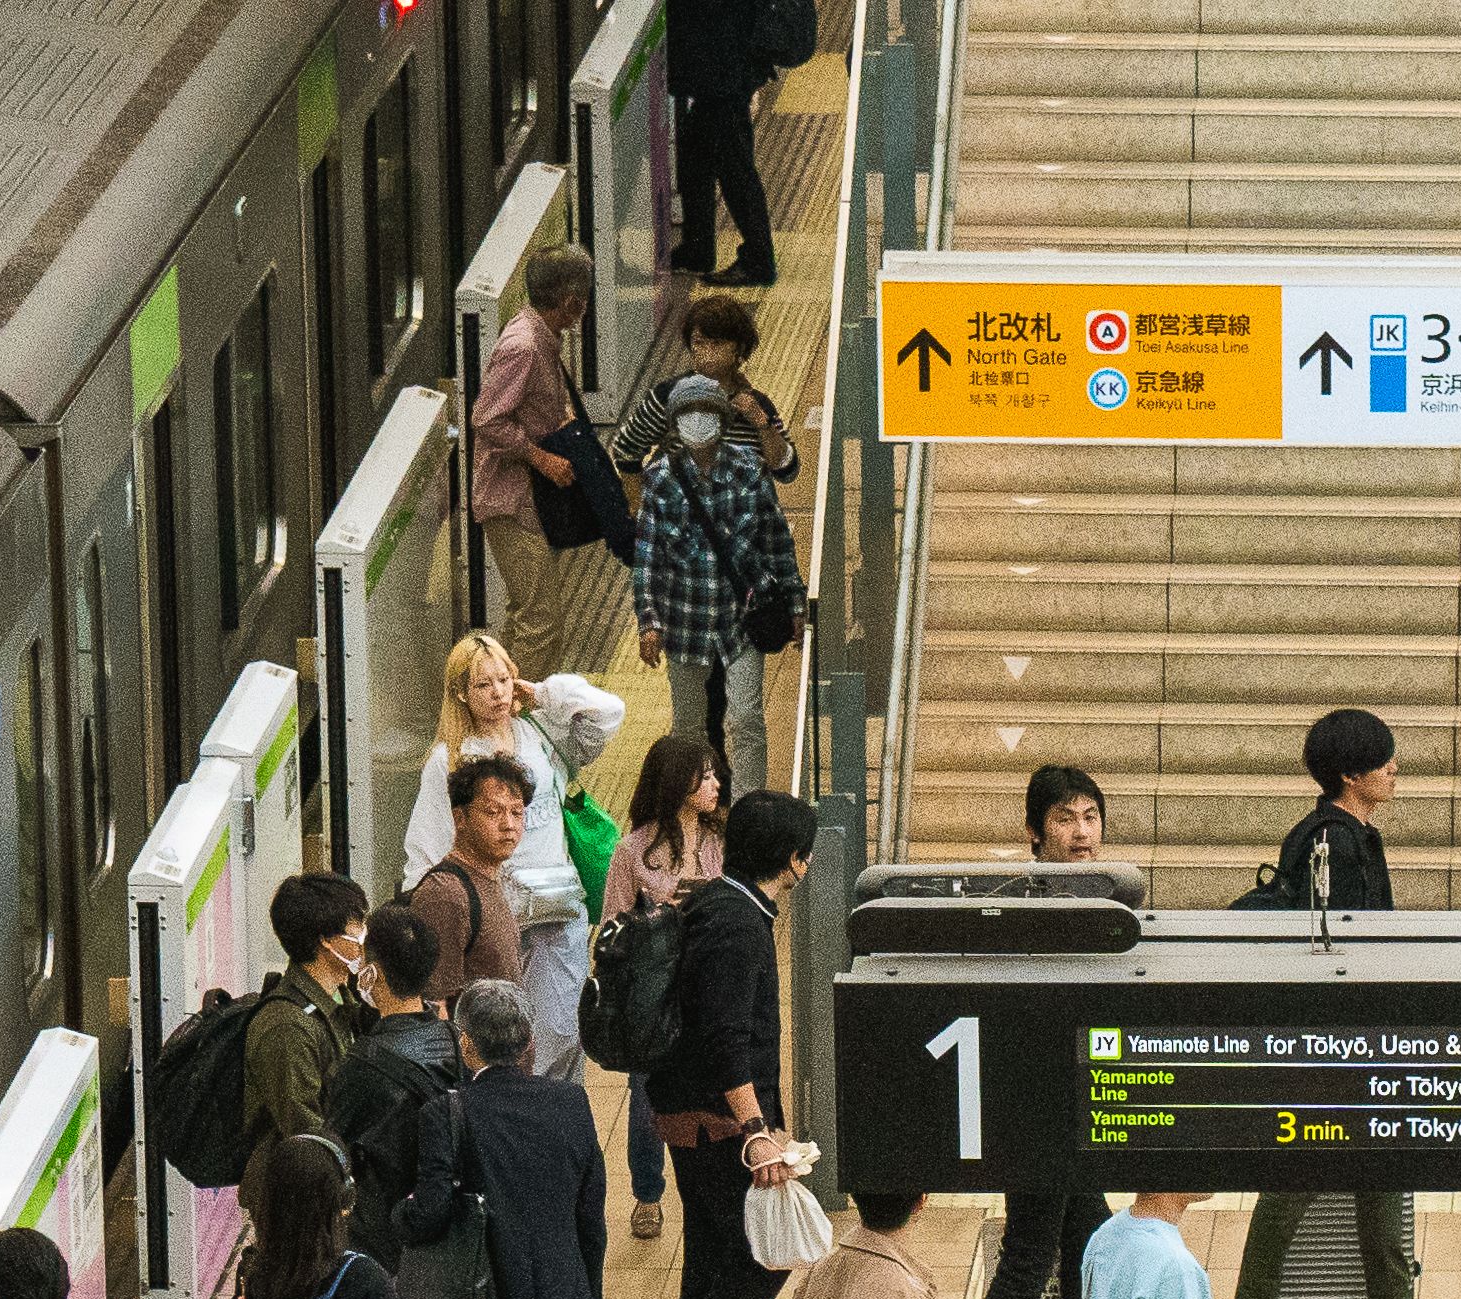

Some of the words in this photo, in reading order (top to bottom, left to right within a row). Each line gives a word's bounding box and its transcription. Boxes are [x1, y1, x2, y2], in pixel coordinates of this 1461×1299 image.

[967, 312, 1061, 342] 北改札
[1101, 325, 1114, 338] A
[1135, 313, 1251, 336] 都営浅草線
[1376, 324, 1400, 342] JK
[1135, 340, 1161, 354] Toei
[1164, 340, 1219, 354] Asakusa
[1222, 340, 1249, 354] Line
[967, 349, 1017, 364] North
[1024, 349, 1067, 365] Gate
[1095, 382, 1120, 396] KK
[1135, 370, 1204, 393] 京急線
[1187, 398, 1217, 411] Line
[1094, 1036, 1115, 1051] JY
[1128, 1035, 1210, 1053] Yamanote
[1214, 1035, 1250, 1053] Line
[1264, 1035, 1296, 1055] for
[1301, 1035, 1374, 1060] Tōkyō,
[1381, 1035, 1439, 1055] Ueno
[1445, 1035, 1461, 1055] &
[1090, 1069, 1175, 1085] Yamanote
[925, 1017, 982, 1160] 1
[1090, 1087, 1128, 1101] Line
[1369, 1076, 1401, 1096] for
[1090, 1111, 1175, 1126] Yamanote
[1090, 1128, 1128, 1142] Line
[1276, 1111, 1297, 1143] 3
[1303, 1120, 1350, 1141] min.
[1369, 1118, 1401, 1138] for
